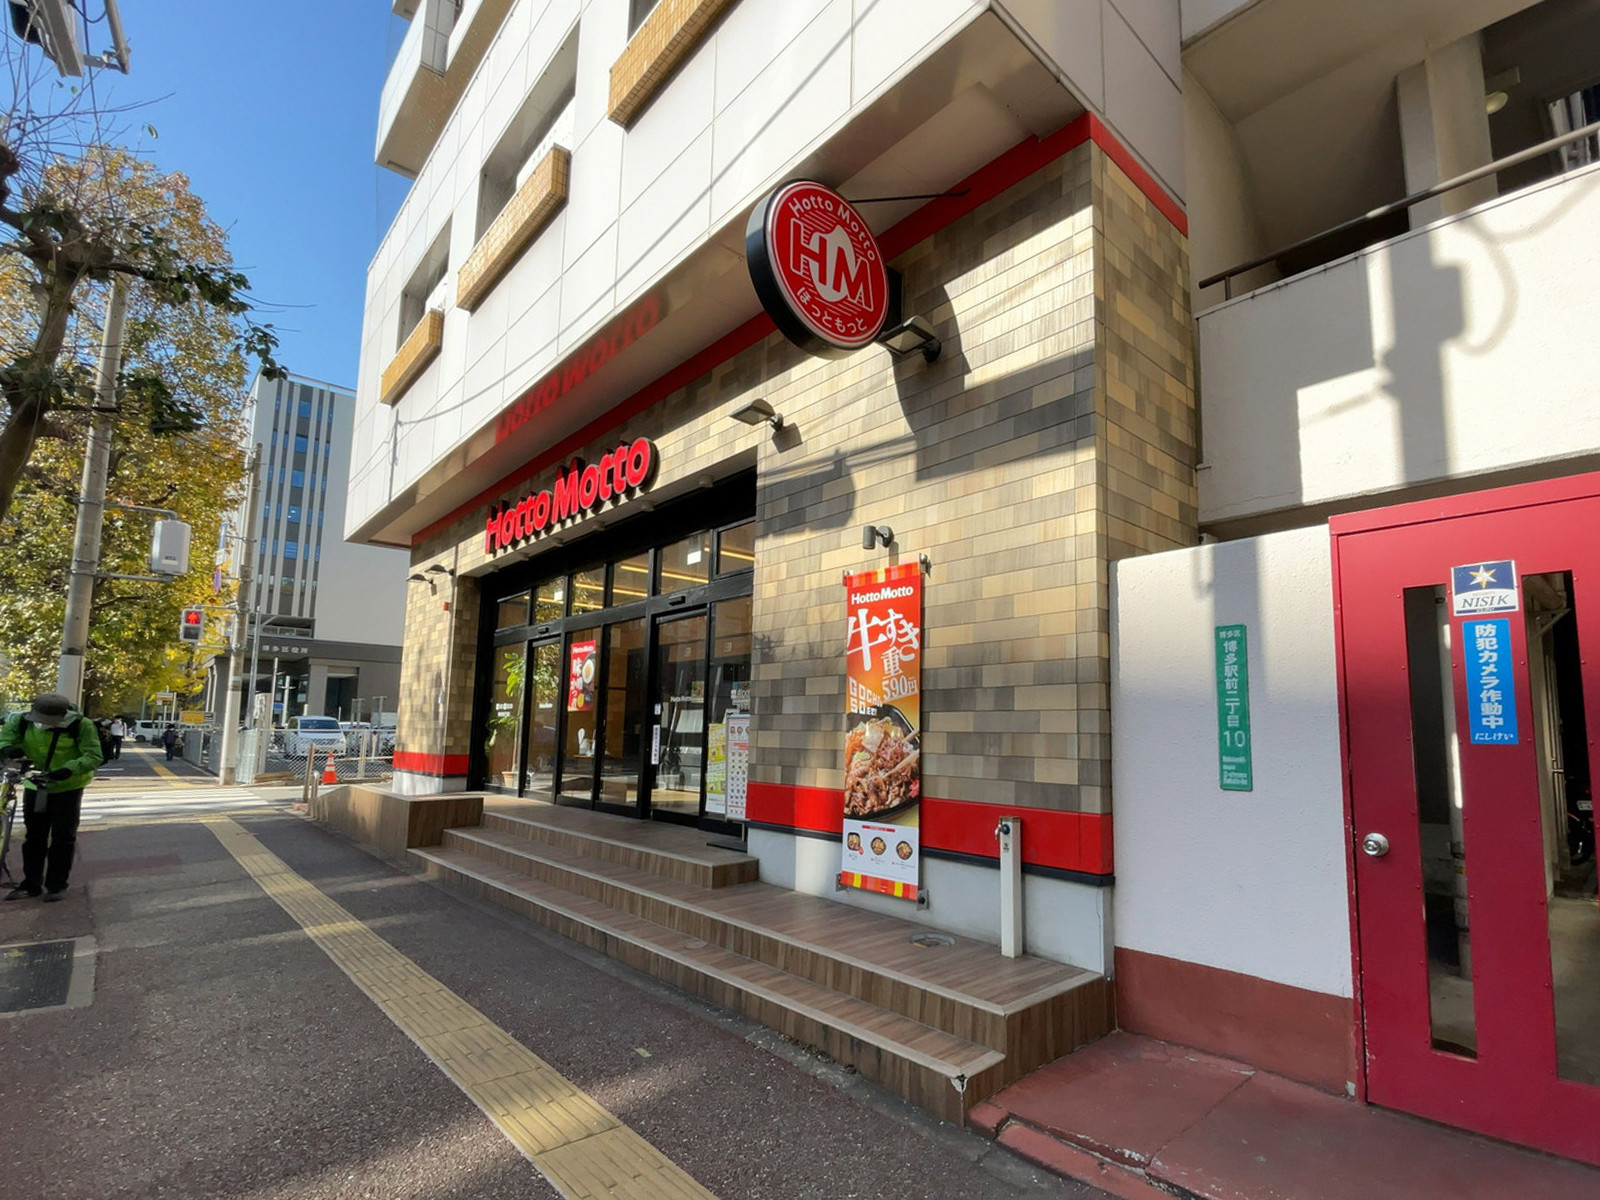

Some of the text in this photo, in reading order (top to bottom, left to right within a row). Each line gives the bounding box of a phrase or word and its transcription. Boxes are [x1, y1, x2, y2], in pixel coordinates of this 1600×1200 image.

[788, 194, 876, 262] Hotto Motto
[796, 286, 867, 335] ほっともっと
[1461, 593, 1509, 608] NISIK
[1223, 640, 1240, 728] 博多駅前二丁目
[1475, 624, 1504, 729] 防犯カメラ作動中
[1223, 729, 1246, 748] 10
[1475, 732, 1514, 741] にしけい
